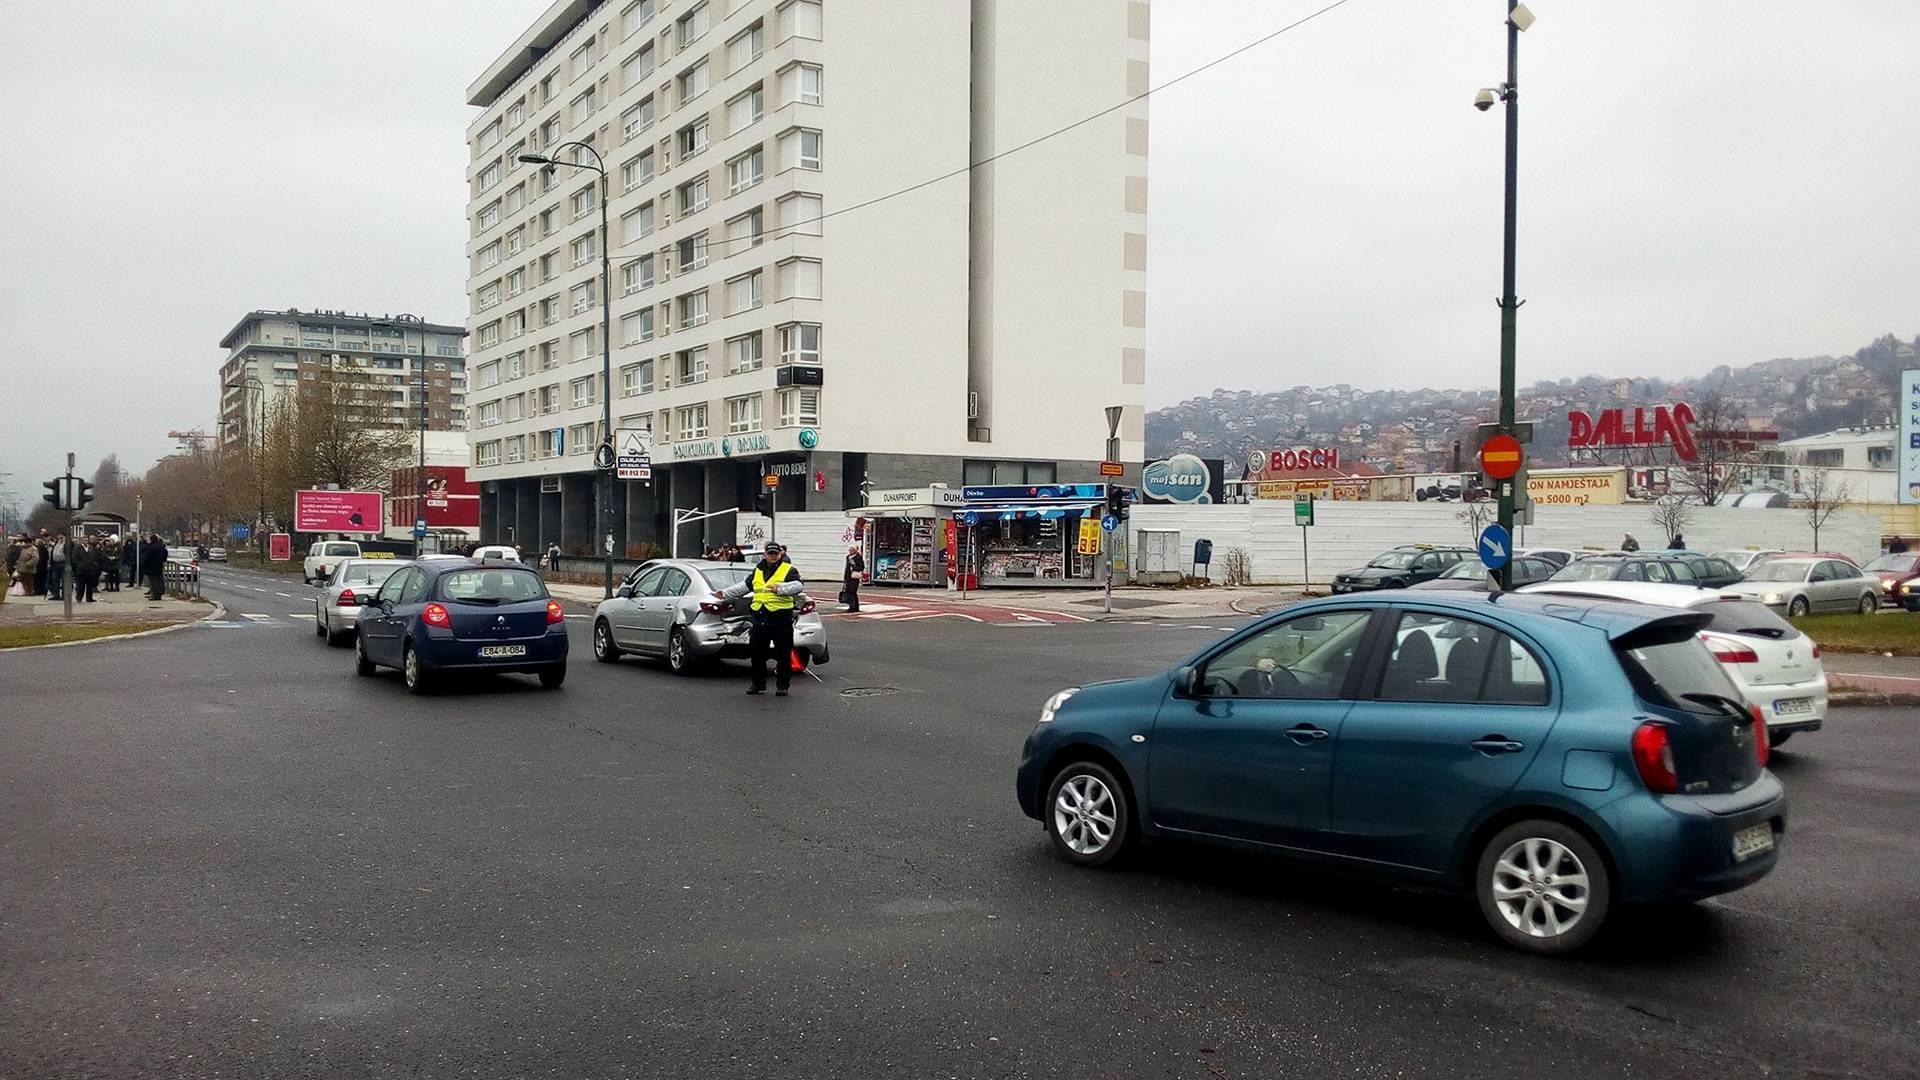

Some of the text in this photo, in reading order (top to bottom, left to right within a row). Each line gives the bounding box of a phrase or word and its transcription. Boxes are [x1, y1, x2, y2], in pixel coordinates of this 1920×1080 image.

[1567, 401, 1697, 463] DALLAS
[1271, 448, 1338, 471] BOSCH
[1547, 478, 1610, 490] NAMJEŠTAJA
[1547, 494, 1571, 504] 5000
